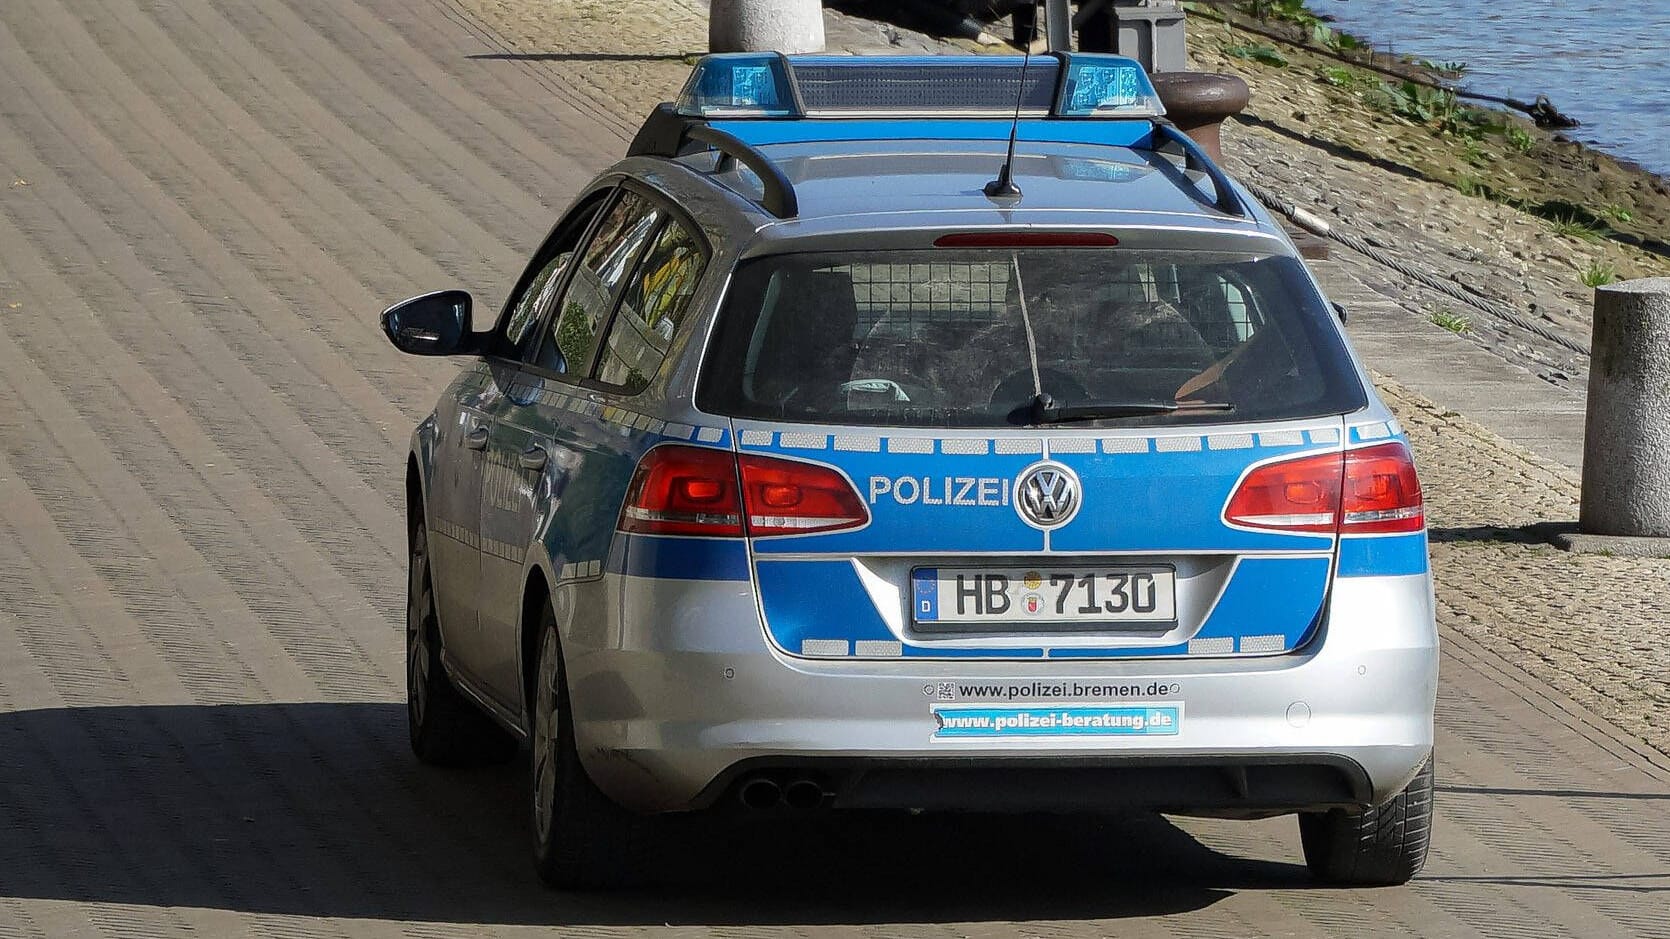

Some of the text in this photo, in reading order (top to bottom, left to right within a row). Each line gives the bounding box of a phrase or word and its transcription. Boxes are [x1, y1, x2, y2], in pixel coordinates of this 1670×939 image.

[869, 476, 1008, 505] POLIZEI
[957, 573, 1156, 615] HB 7130
[921, 600, 931, 612] D
[959, 681, 1169, 700] www.polizei.bremen.de
[942, 711, 1173, 731] www.polizei-beratung.de
